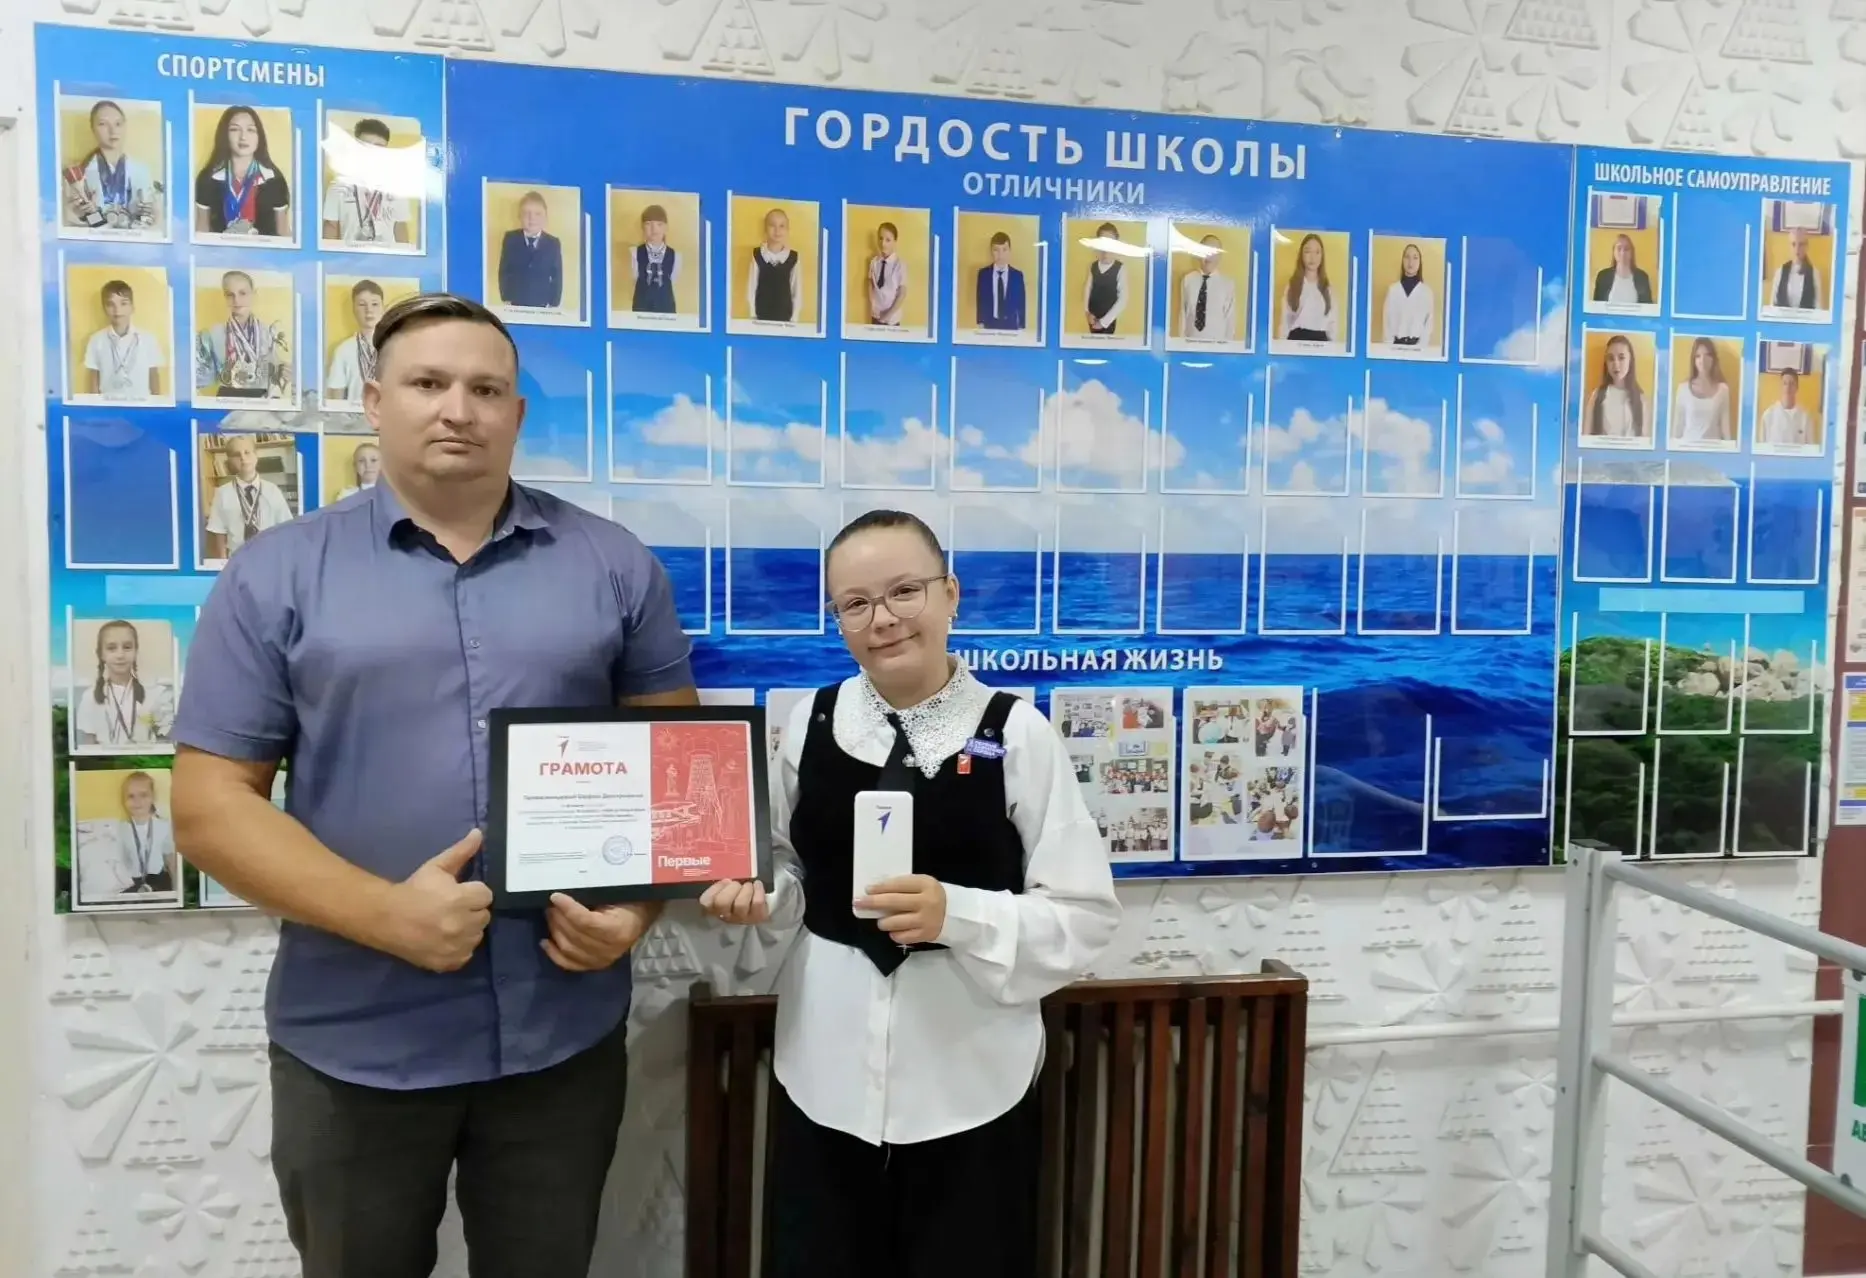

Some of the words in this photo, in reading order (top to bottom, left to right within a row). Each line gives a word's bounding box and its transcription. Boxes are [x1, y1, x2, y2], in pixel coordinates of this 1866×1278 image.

[157, 53, 325, 87] СПОРТСМЕНЫ
[784, 107, 1084, 165] ГОРДОСТЬ
[1106, 131, 1307, 180] ШКОЛЫ
[963, 172, 1146, 205] ОТЛИЧНИКИ
[1595, 162, 1684, 187] ШКОЛЬНОЕ
[1687, 170, 1832, 196] САМОУПРАВЛЕНИЕ
[1123, 648, 1224, 671] ЖИЗНЬ
[540, 762, 628, 776] ГРАМОТА
[658, 856, 711, 870] Первые
